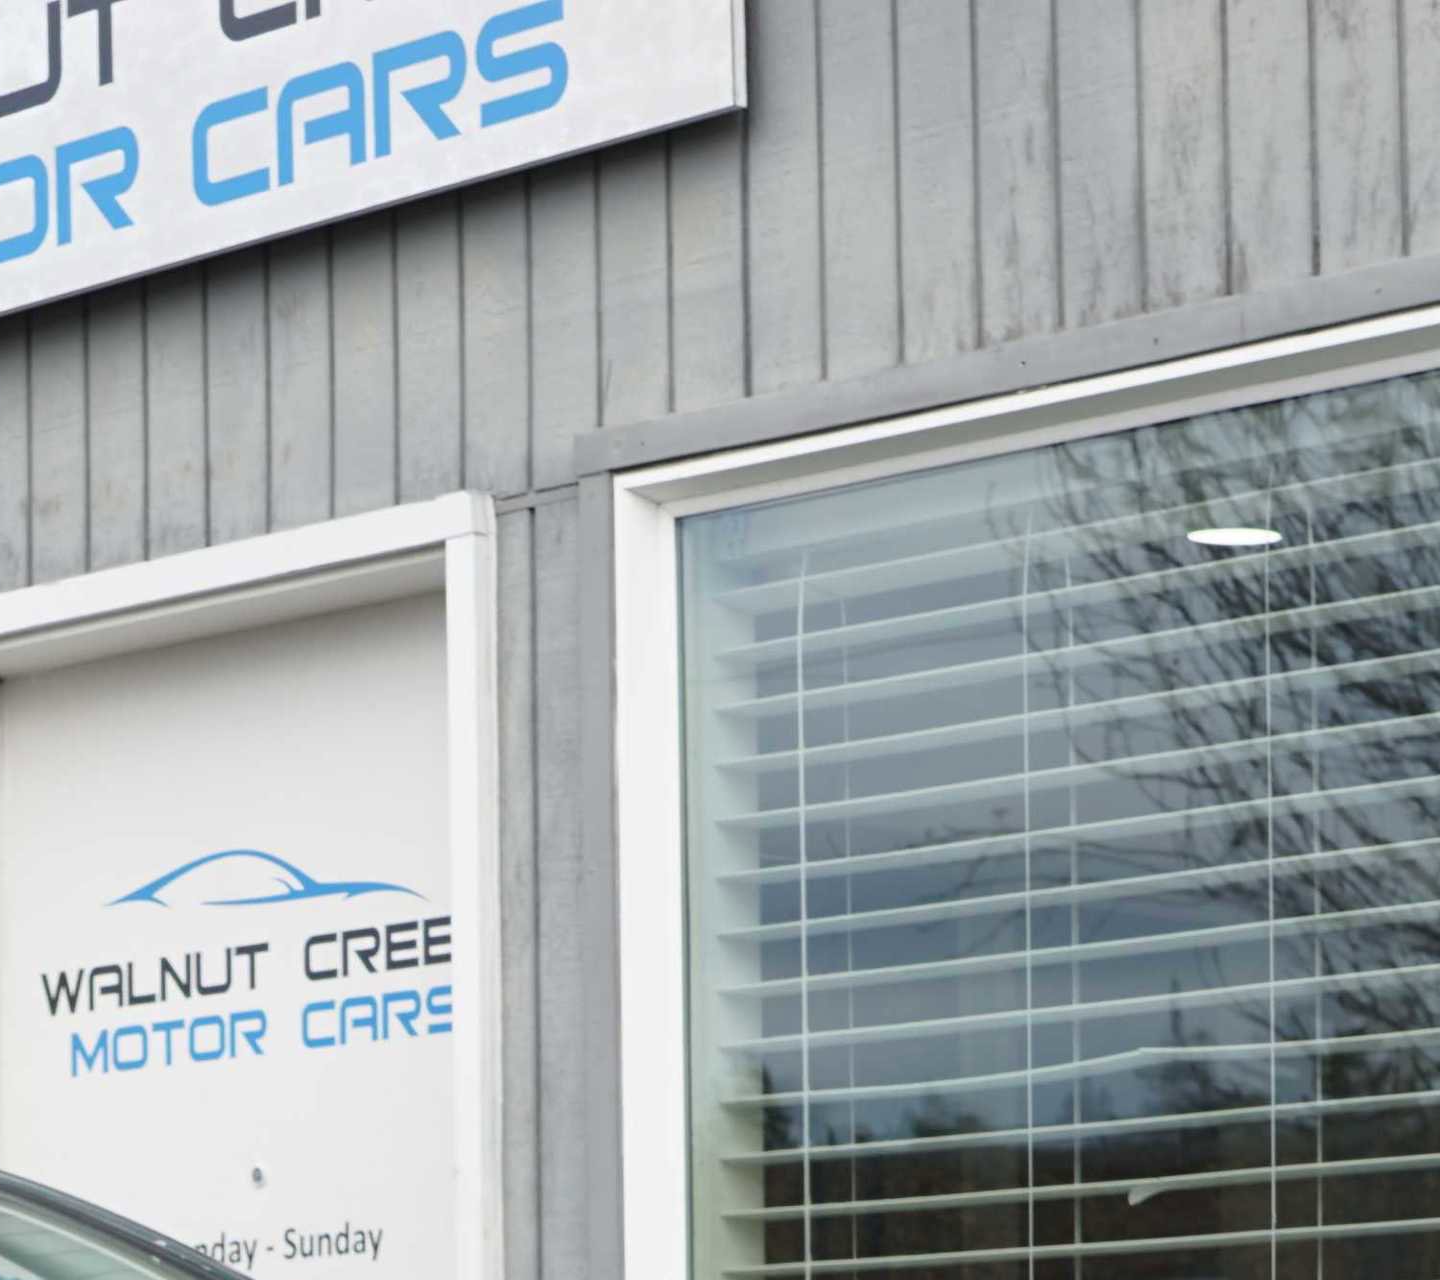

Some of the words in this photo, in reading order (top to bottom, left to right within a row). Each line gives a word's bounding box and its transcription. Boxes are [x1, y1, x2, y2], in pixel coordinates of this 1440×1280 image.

[192, 0, 569, 208] CARS
[41, 942, 269, 1016] WALNUT
[304, 915, 452, 981] CREE
[70, 1009, 268, 1077] MOTOR
[302, 984, 453, 1049] CARS
[194, 1231, 258, 1270] nday
[283, 1221, 383, 1261] Sunday
